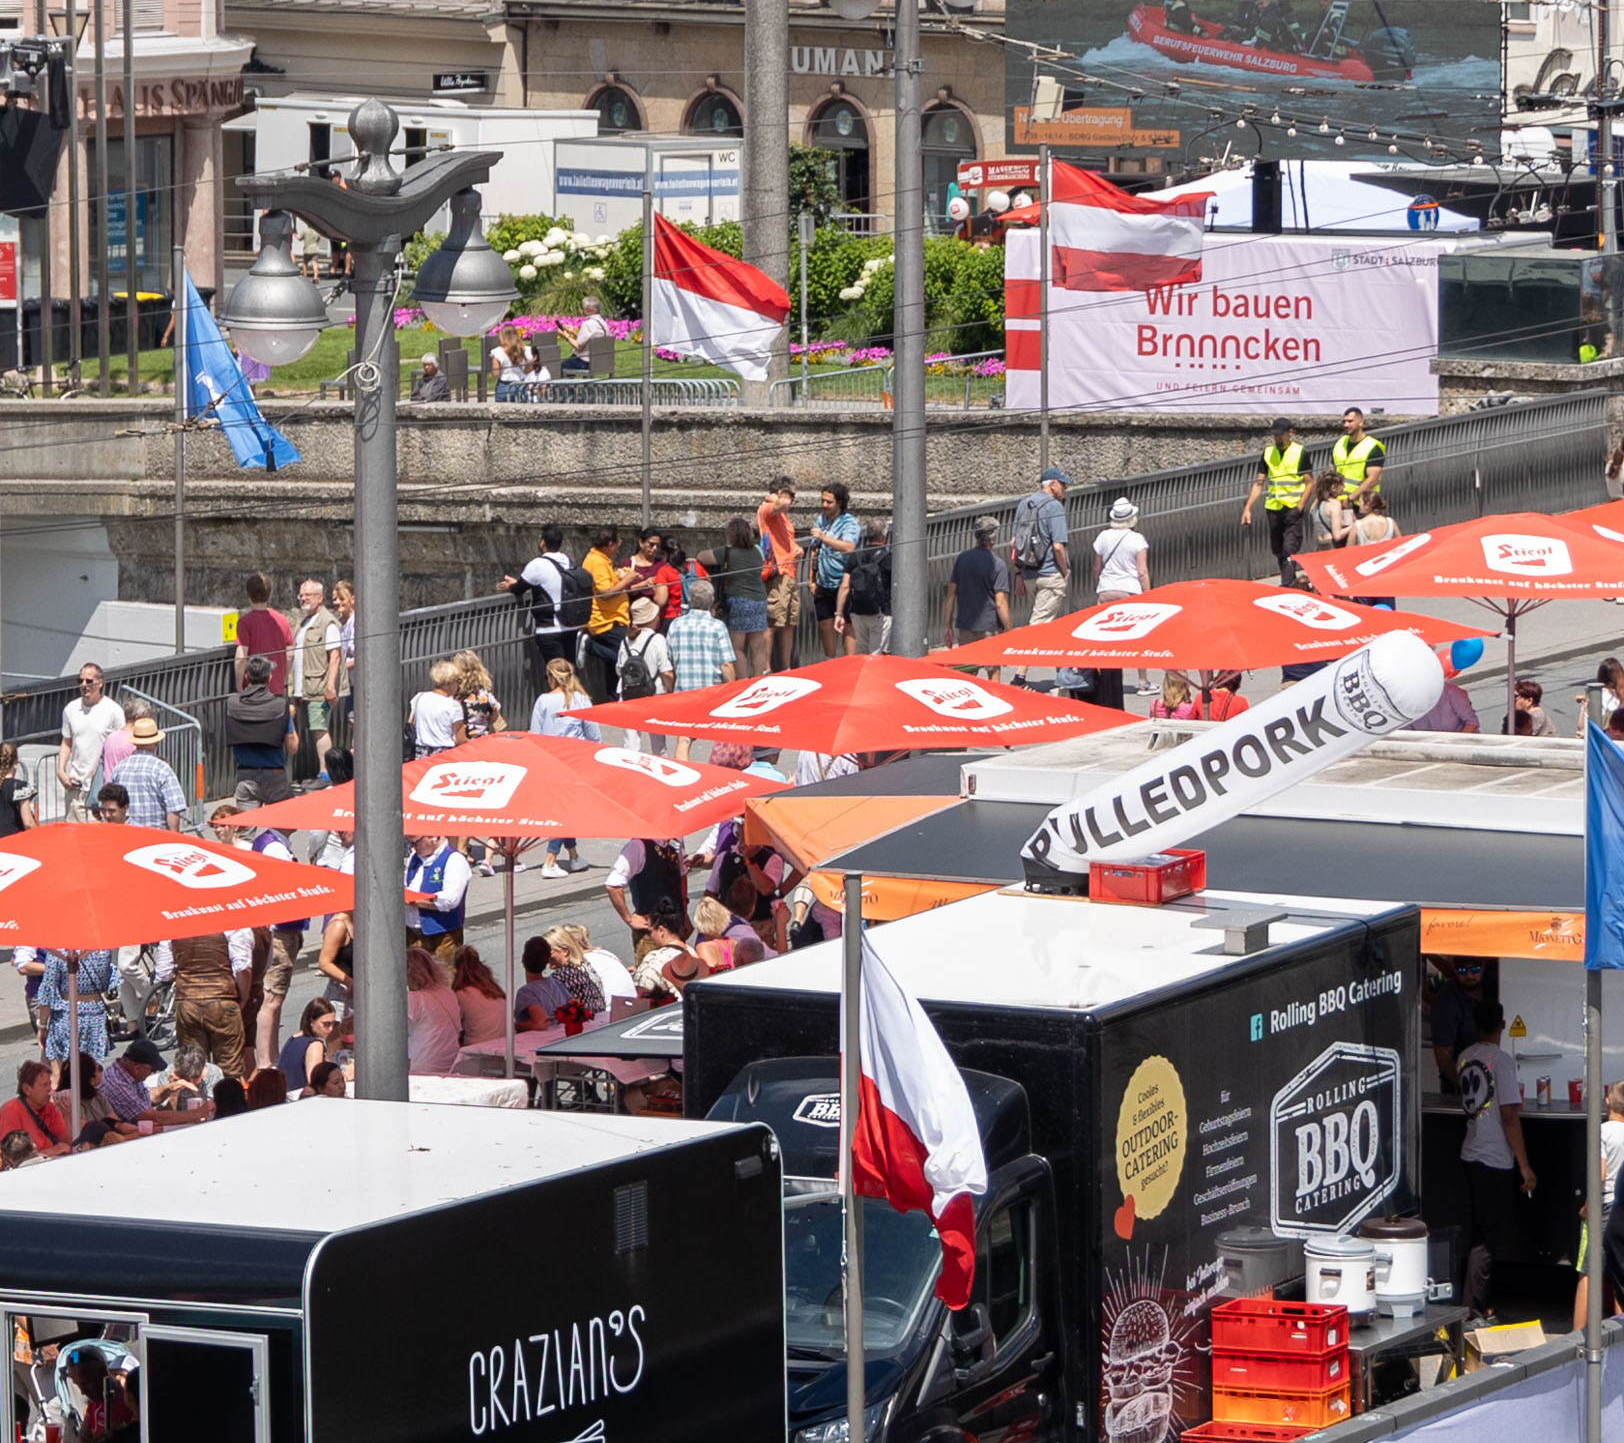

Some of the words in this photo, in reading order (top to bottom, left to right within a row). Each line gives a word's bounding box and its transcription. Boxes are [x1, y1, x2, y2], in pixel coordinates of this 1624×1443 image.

[1152, 34, 1243, 64] BERUFSFEUERWEHR
[1245, 54, 1299, 75] SALZBURG
[718, 151, 737, 164] WC
[1144, 282, 1199, 317] Wir
[1212, 285, 1313, 320] bauen
[1156, 381, 1181, 393] UND
[1232, 384, 1302, 397] GEMEINSAM
[1095, 609, 1161, 626] Stiegl
[1340, 667, 1388, 734] BBQ
[430, 771, 506, 790] Stiegl
[1269, 1000, 1317, 1035] Rolling
[1318, 985, 1346, 1016] BBQ
[1348, 969, 1403, 1005] Catering
[1136, 1083, 1160, 1105] Cooles
[1220, 1089, 1232, 1105] für
[1305, 1075, 1367, 1115] ROLLING
[1137, 1098, 1166, 1124] flexibles
[1198, 1106, 1253, 1136] Geburtstagsfeiern
[1121, 1109, 1180, 1160] OUTDOOR-
[1201, 1130, 1250, 1158] Hochzeitsfeiern
[1294, 1099, 1380, 1199] BBQ
[1124, 1130, 1180, 1182] CATERING
[1204, 1155, 1246, 1180] Firmenfeiern
[1139, 1160, 1170, 1193] gesucht?
[1192, 1173, 1259, 1207] Geschäftseröffnungen
[1294, 1173, 1362, 1216] CATERING
[1200, 1197, 1252, 1228] Business-Brunch
